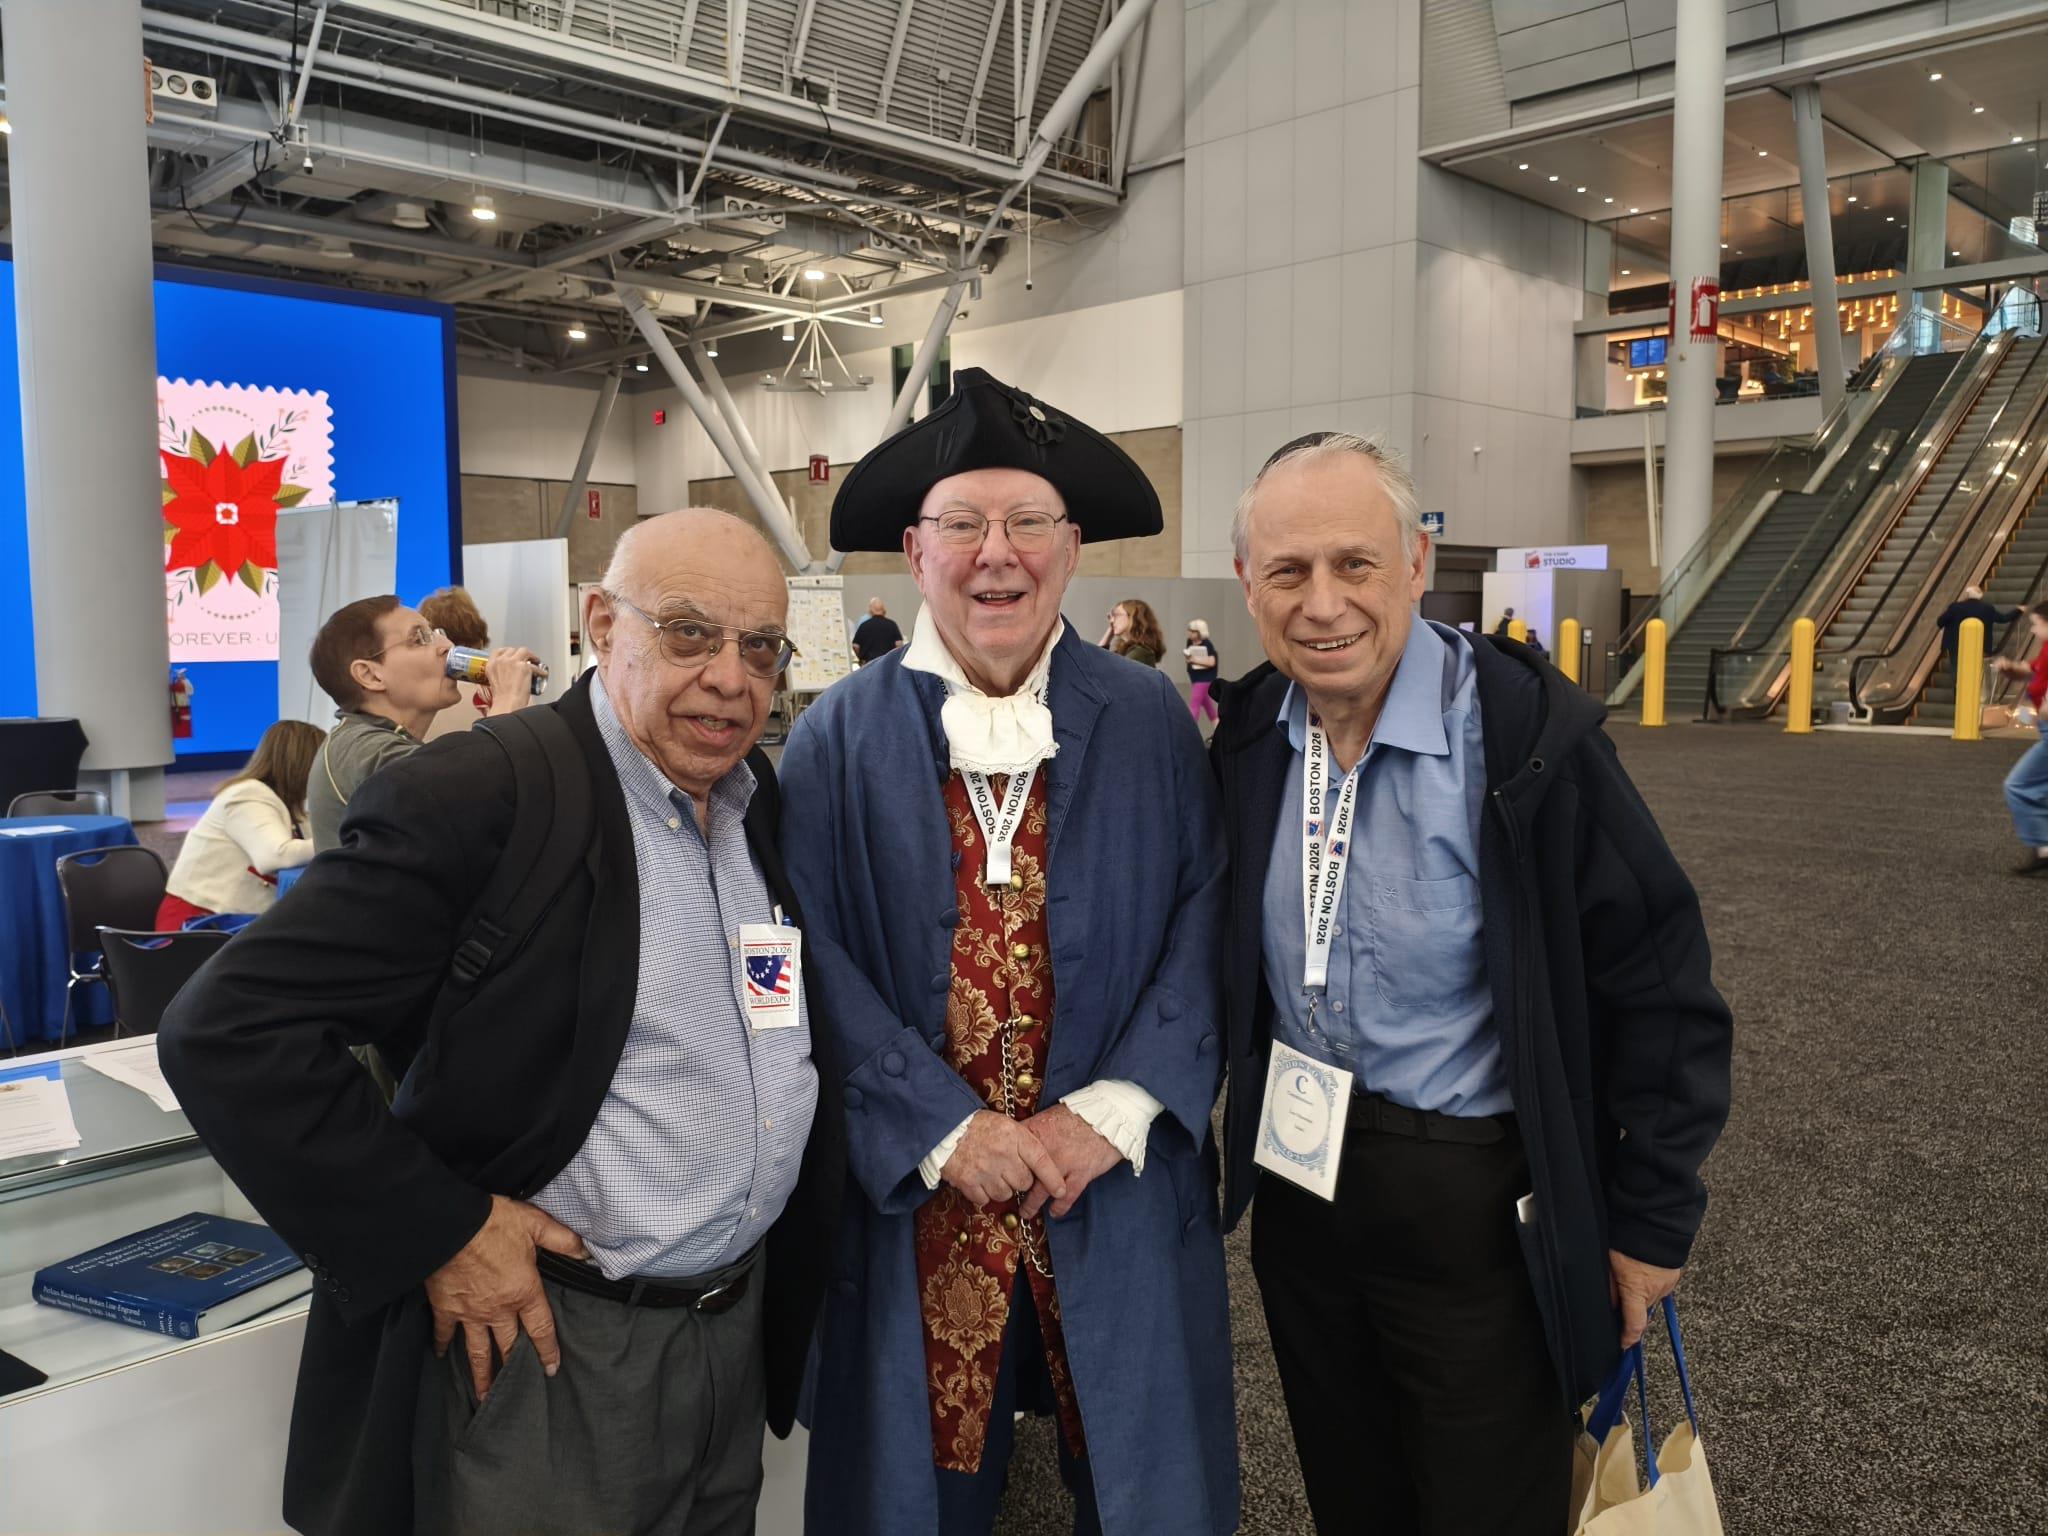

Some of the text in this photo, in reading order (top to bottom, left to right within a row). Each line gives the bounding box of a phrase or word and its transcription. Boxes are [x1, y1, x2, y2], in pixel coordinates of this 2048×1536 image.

[1543, 557, 1576, 567] STUDIO
[169, 632, 278, 647] OREVER U
[1310, 732, 1322, 815] BOSTON 2026
[968, 770, 995, 835] BOSTON 20
[998, 771, 1029, 843] BOSTON 2026
[1337, 773, 1357, 835] TON 2026
[1309, 842, 1320, 871] 2026
[1316, 861, 1340, 945] BOSTON 2026
[744, 946, 792, 955] BOSTON 2026
[749, 996, 769, 1004] WORLD
[1296, 1075, 1308, 1095] C
